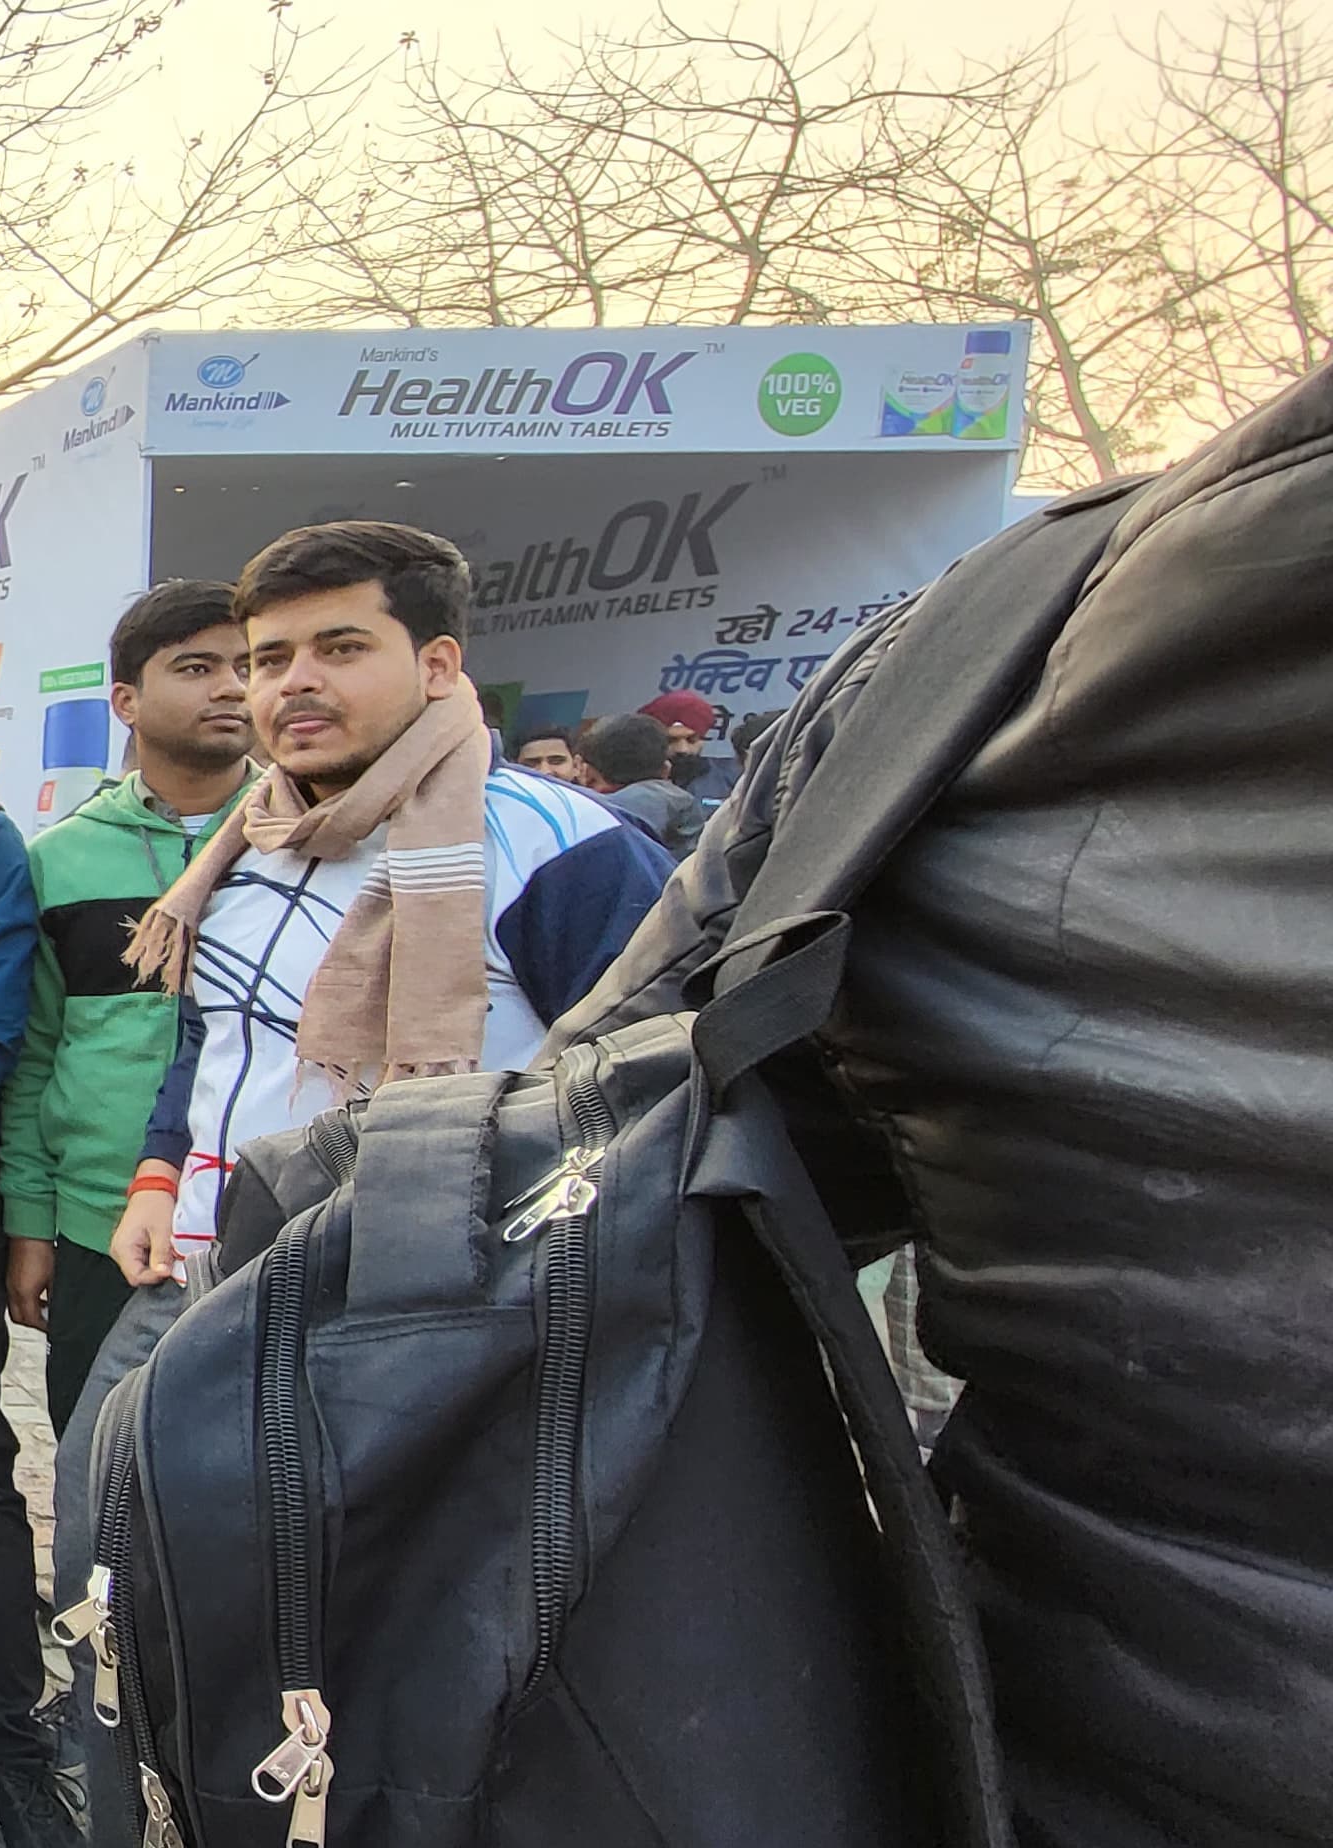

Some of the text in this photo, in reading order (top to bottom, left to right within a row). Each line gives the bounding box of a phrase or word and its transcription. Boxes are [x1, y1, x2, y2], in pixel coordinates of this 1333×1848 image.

[359, 347, 439, 363] Mankind's
[706, 342, 726, 354] TM
[337, 351, 699, 416] HealthOK
[764, 372, 836, 395] 100%
[164, 391, 263, 412] Mankind
[776, 397, 822, 416] VEG
[62, 408, 121, 452] Mankind
[389, 421, 672, 438] MULTIVITAMIN TABLETS
[470, 481, 754, 609] althOK
[605, 584, 720, 619] TABLETS
[715, 604, 782, 645] रहो
